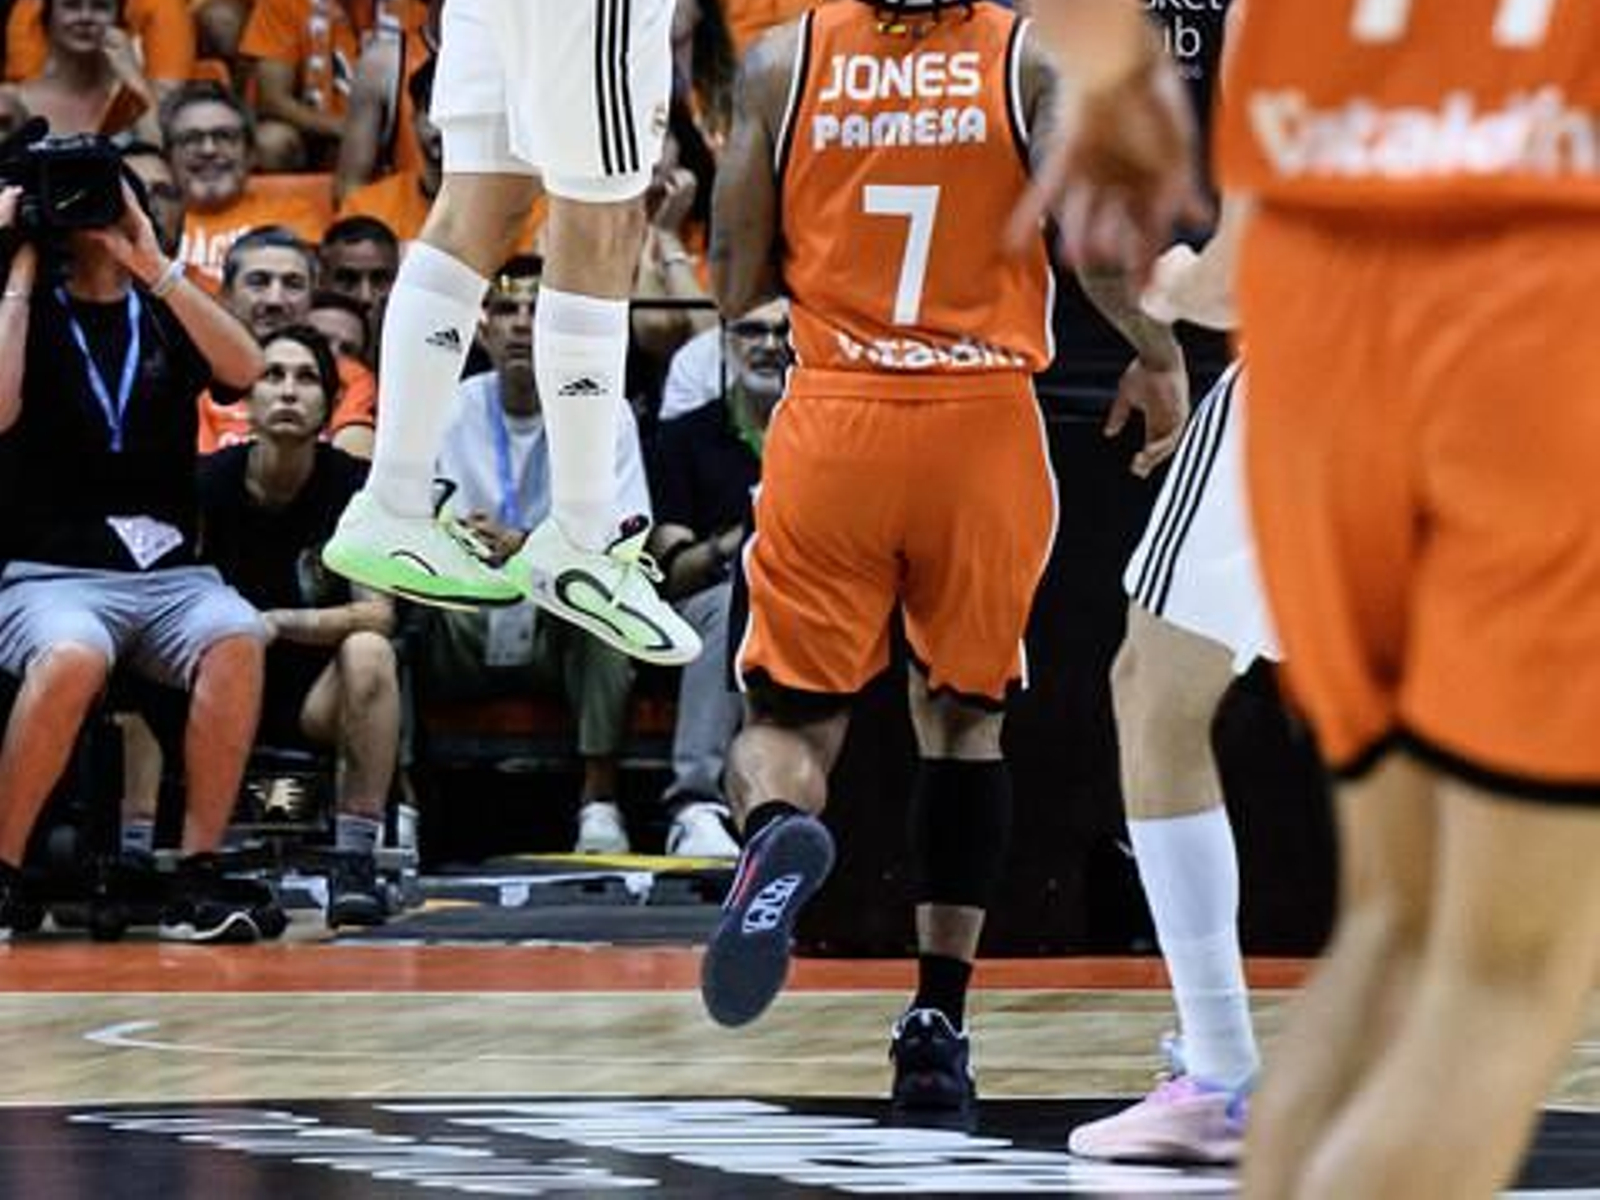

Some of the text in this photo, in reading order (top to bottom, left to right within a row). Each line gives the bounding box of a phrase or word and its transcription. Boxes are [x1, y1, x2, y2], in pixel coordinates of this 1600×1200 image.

[819, 52, 980, 100] JONES
[812, 106, 987, 150] PAMESA
[863, 185, 940, 325] 7
